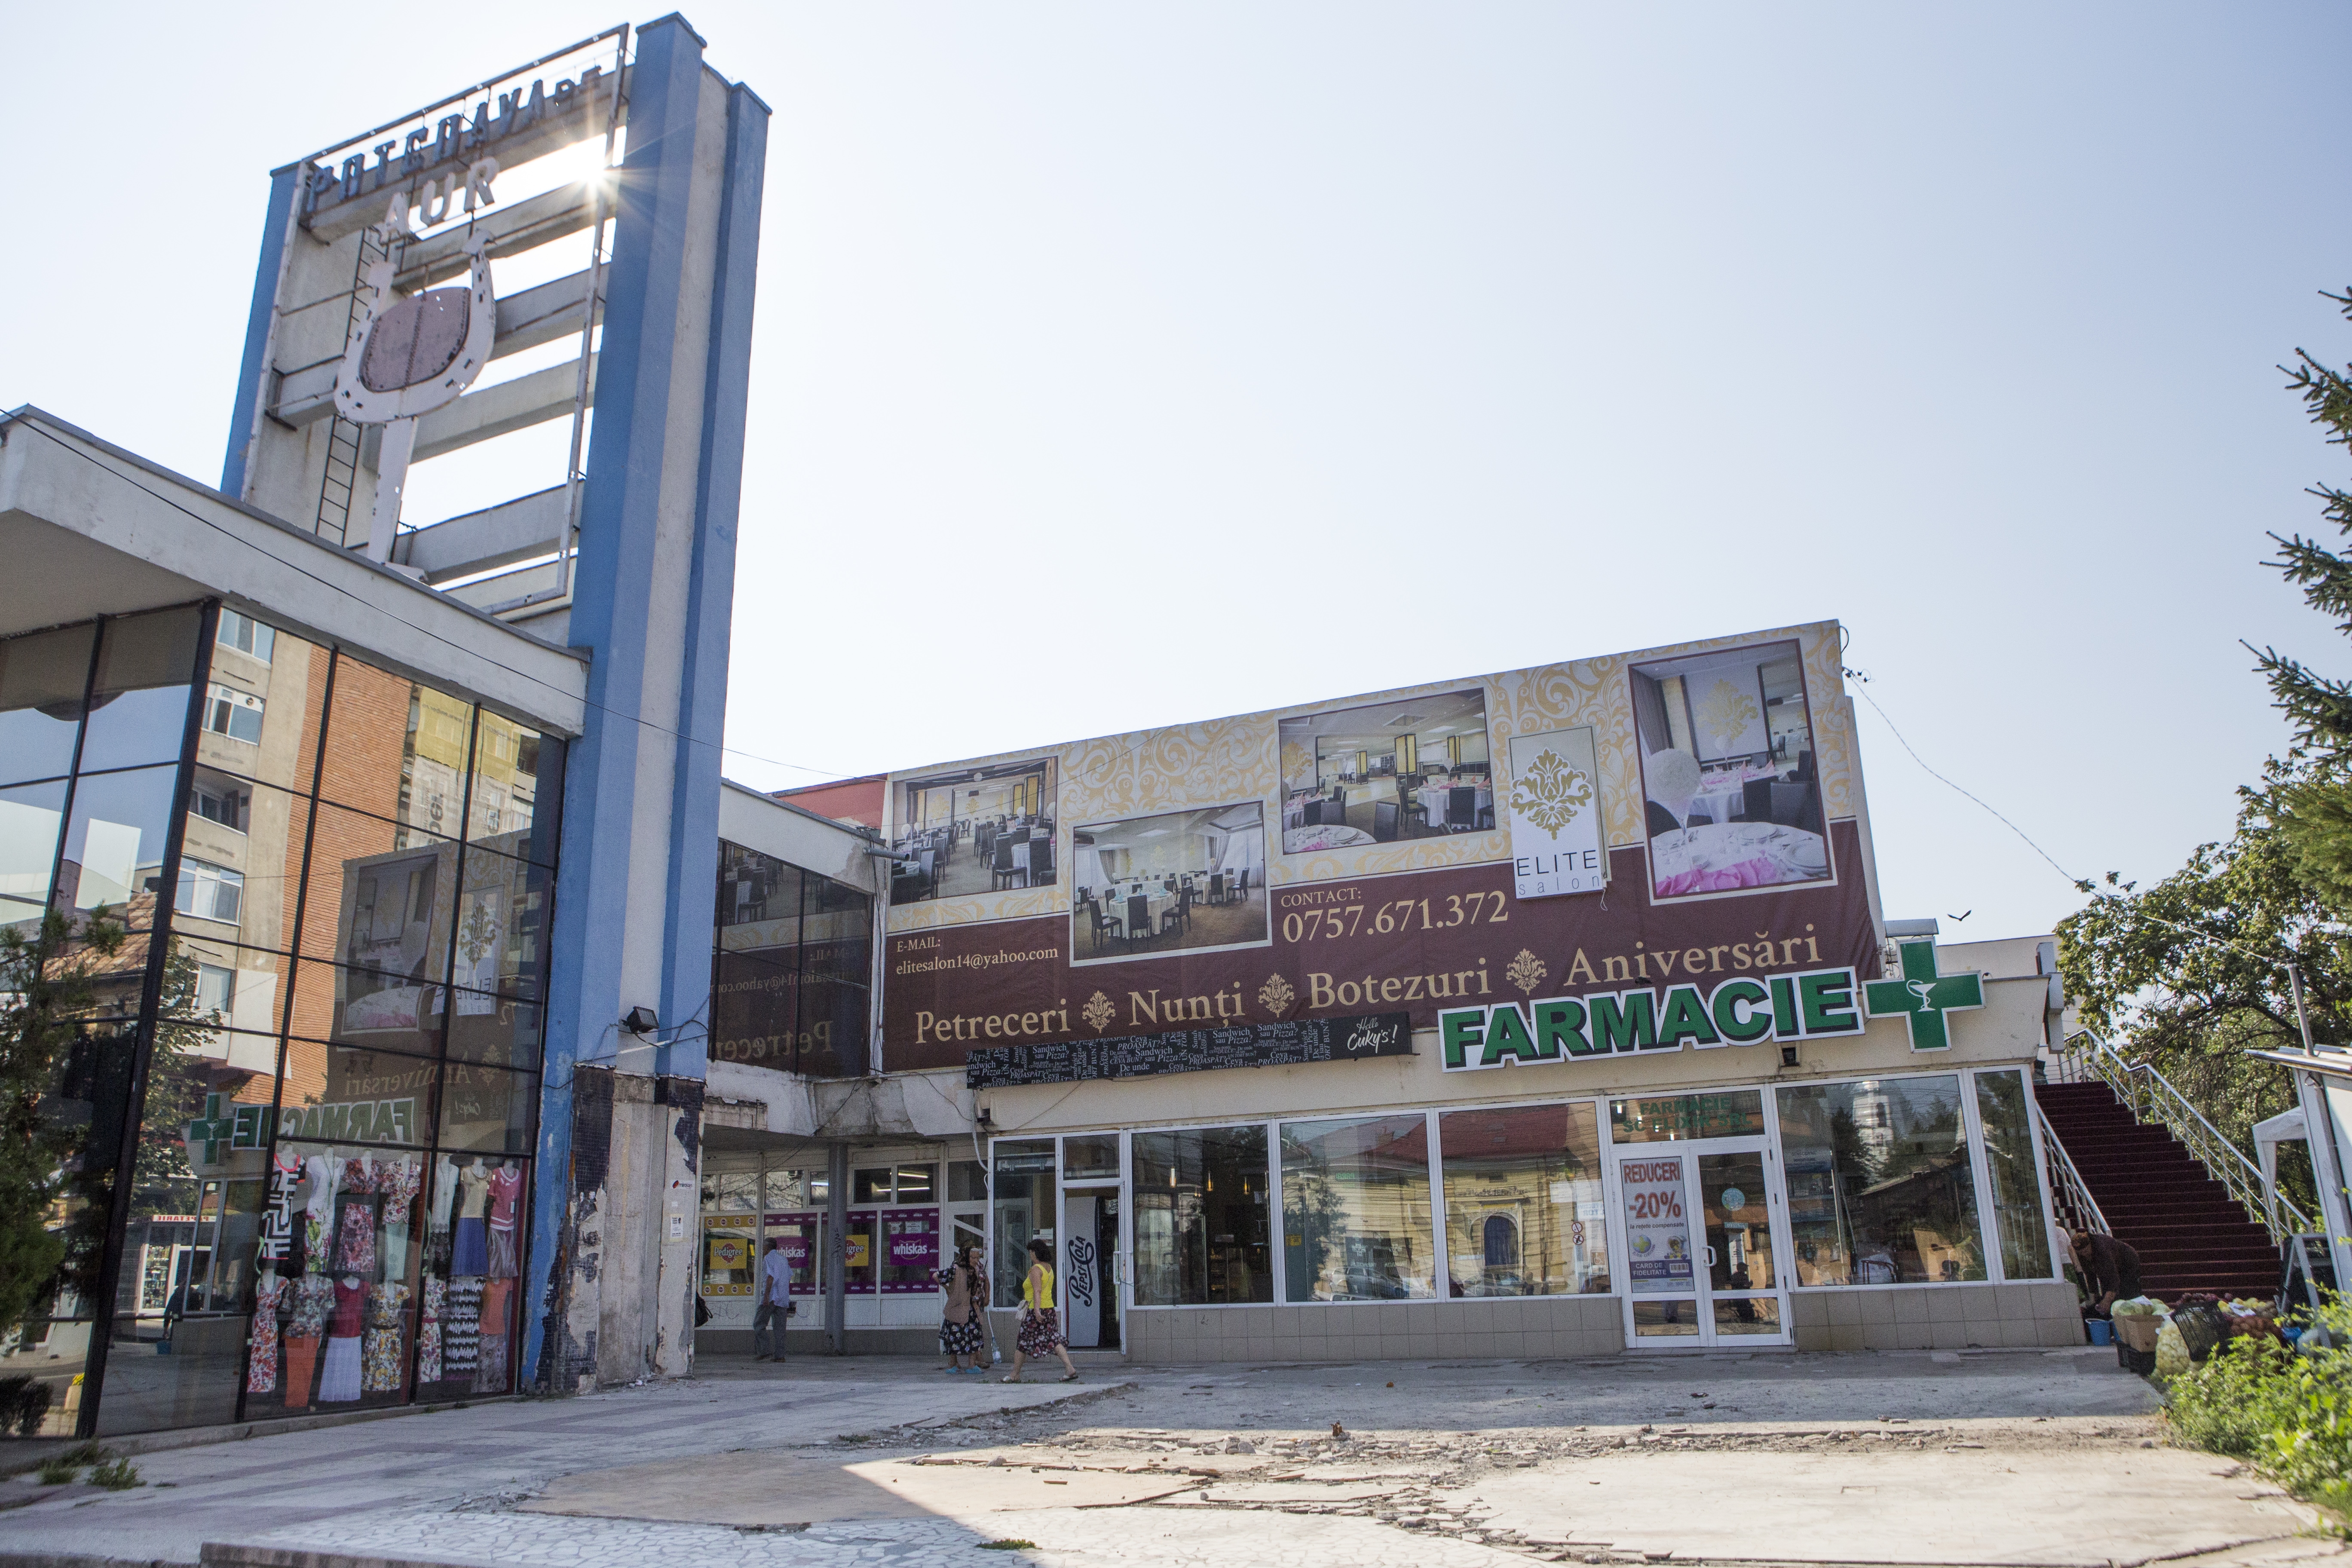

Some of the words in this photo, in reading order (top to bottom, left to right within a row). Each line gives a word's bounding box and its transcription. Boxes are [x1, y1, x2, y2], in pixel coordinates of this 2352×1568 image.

[389, 156, 500, 234] AUR
[1516, 850, 1598, 876] ELITE
[1519, 876, 1599, 895] salon
[1281, 887, 1362, 907] CONTACT:
[1282, 890, 1508, 943] 0757.671.372
[897, 937, 940, 952] E-MAIL:
[896, 948, 1058, 974] elitesalon14@yahoo.com
[916, 998, 1071, 1044] Petreceri
[1307, 957, 1492, 1009] Botezuri
[1563, 923, 1823, 987] Aniversări
[1257, 1021, 1295, 1031] Sandwich
[1357, 1017, 1379, 1033] Hello
[1441, 969, 1860, 1069] FARMACIE
[1213, 1027, 1250, 1038] Sandwich
[1228, 1035, 1253, 1044] Pizza?
[1273, 1028, 1298, 1038] Pizza?
[1033, 1044, 1066, 1054] Sandwich
[1046, 1050, 1069, 1060] Pizza?
[1136, 1046, 1173, 1057] Sandwich
[967, 1060, 996, 1069] andwich
[1132, 1063, 1150, 1071] unde
[1639, 1097, 1732, 1115] FARMACIE
[1623, 1120, 1646, 1133] SC
[1718, 1112, 1753, 1127] SRL
[1623, 1161, 1681, 1183] REDUCERI
[1629, 1190, 1681, 1219] -20%
[714, 1246, 743, 1258] Pedigree
[845, 1245, 864, 1255] igree
[893, 1243, 928, 1255] whiskas
